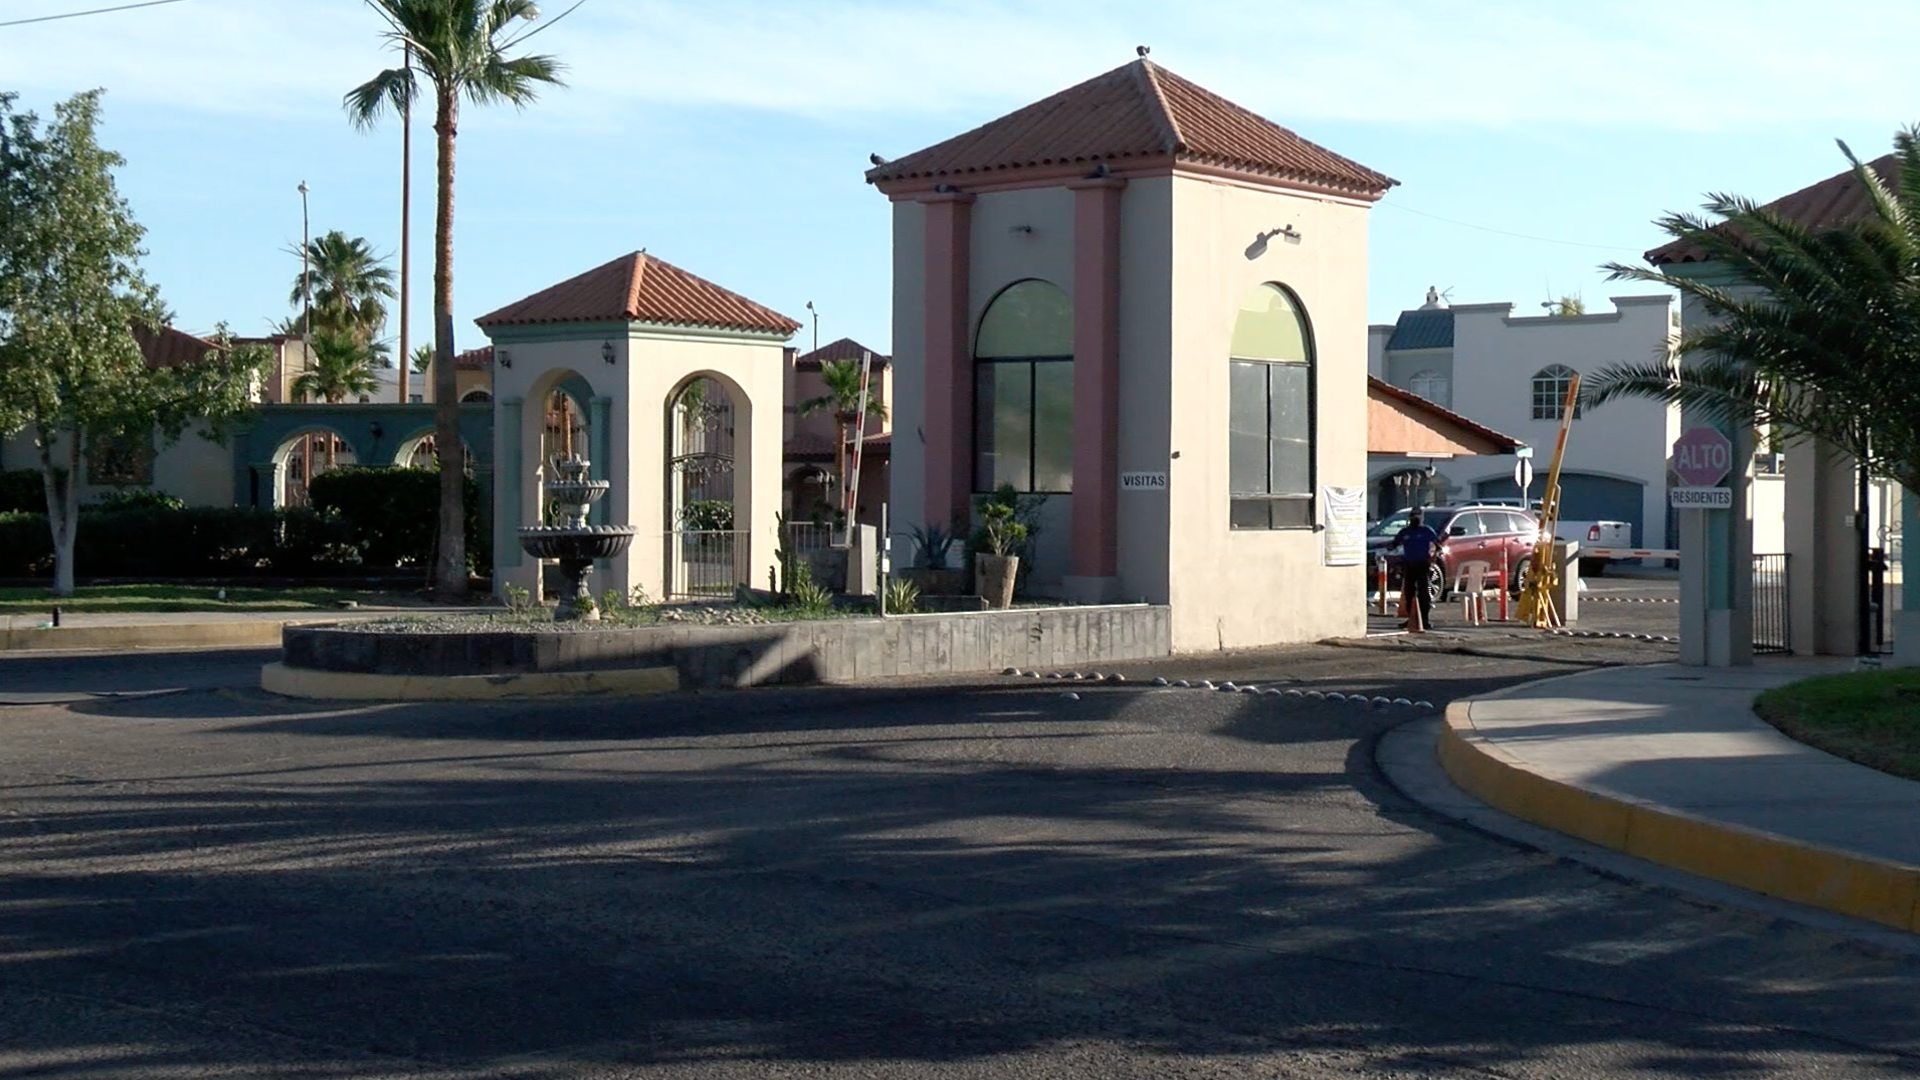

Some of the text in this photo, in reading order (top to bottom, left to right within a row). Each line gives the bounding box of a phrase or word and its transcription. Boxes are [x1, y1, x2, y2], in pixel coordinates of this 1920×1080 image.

[1678, 443, 1727, 469] ALTO
[1123, 475, 1165, 487] VISITAS
[1672, 491, 1730, 505] RESIDENTES
